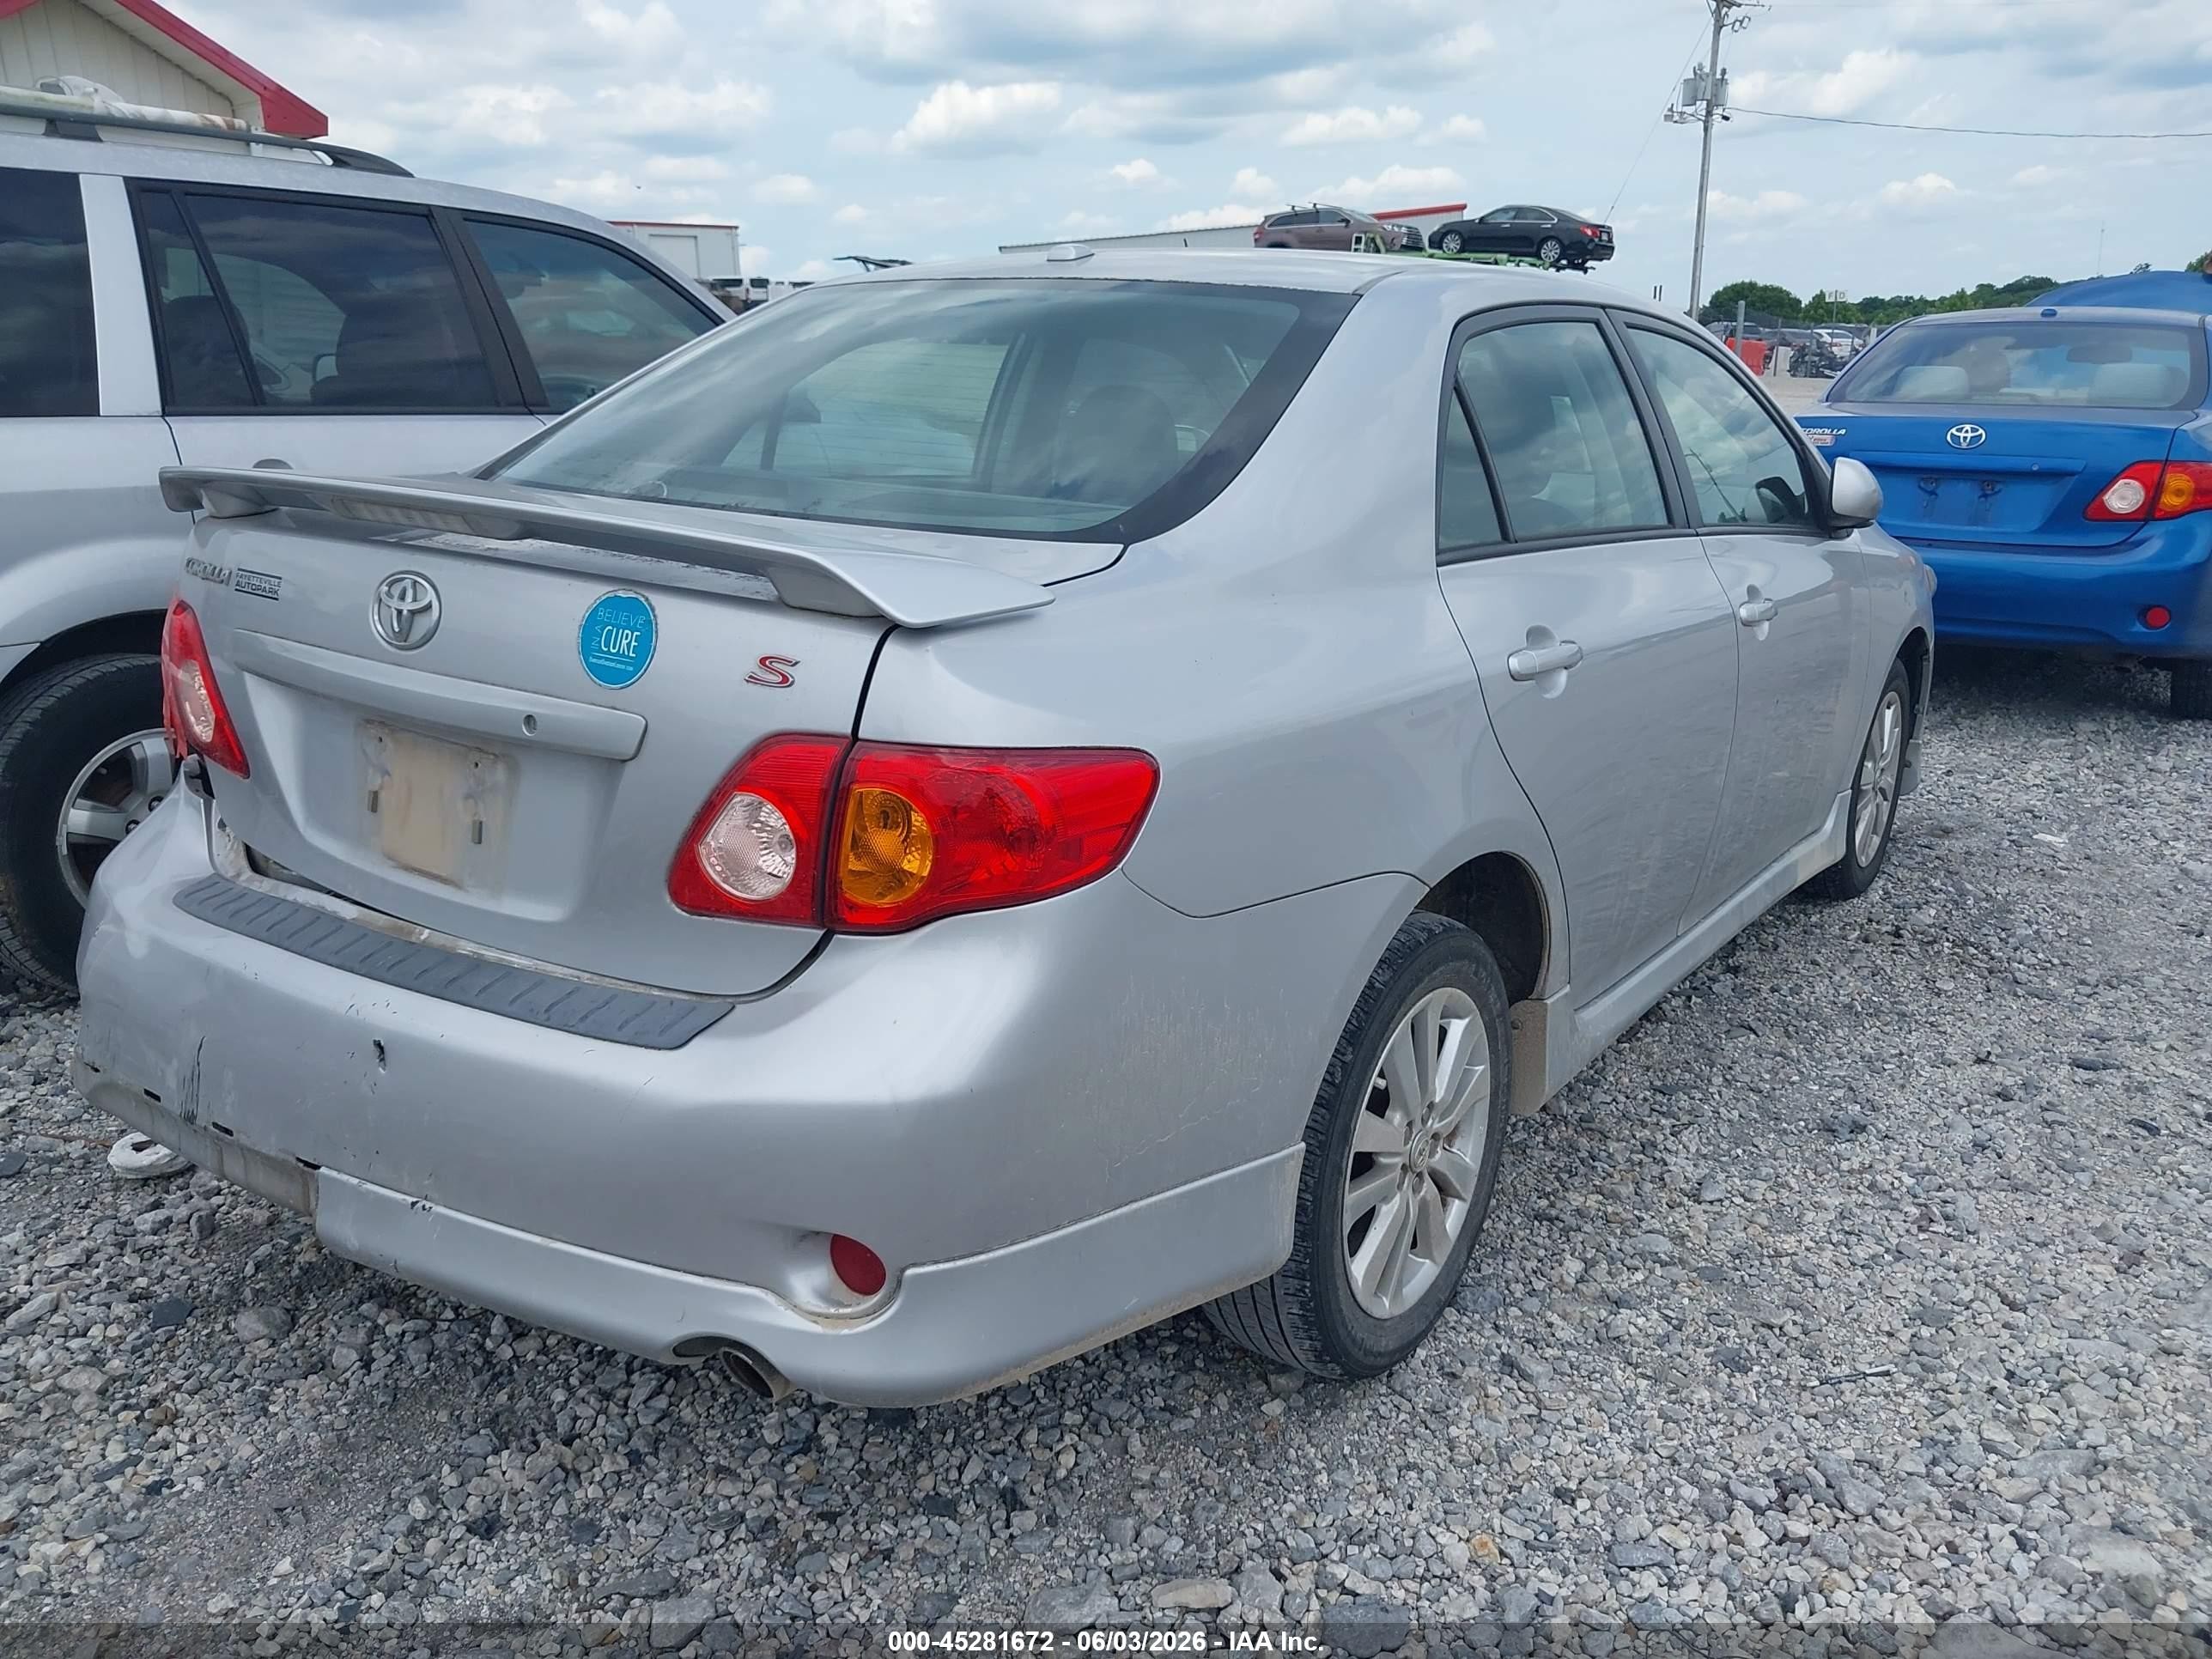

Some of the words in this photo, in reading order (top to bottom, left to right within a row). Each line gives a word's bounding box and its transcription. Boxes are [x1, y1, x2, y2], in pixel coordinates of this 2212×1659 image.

[234, 580, 280, 598] AUTOPARK
[235, 572, 282, 588] FAYETTEVILLE
[597, 607, 646, 629] BELIEVE
[601, 625, 641, 658] CURE
[744, 654, 801, 689] S
